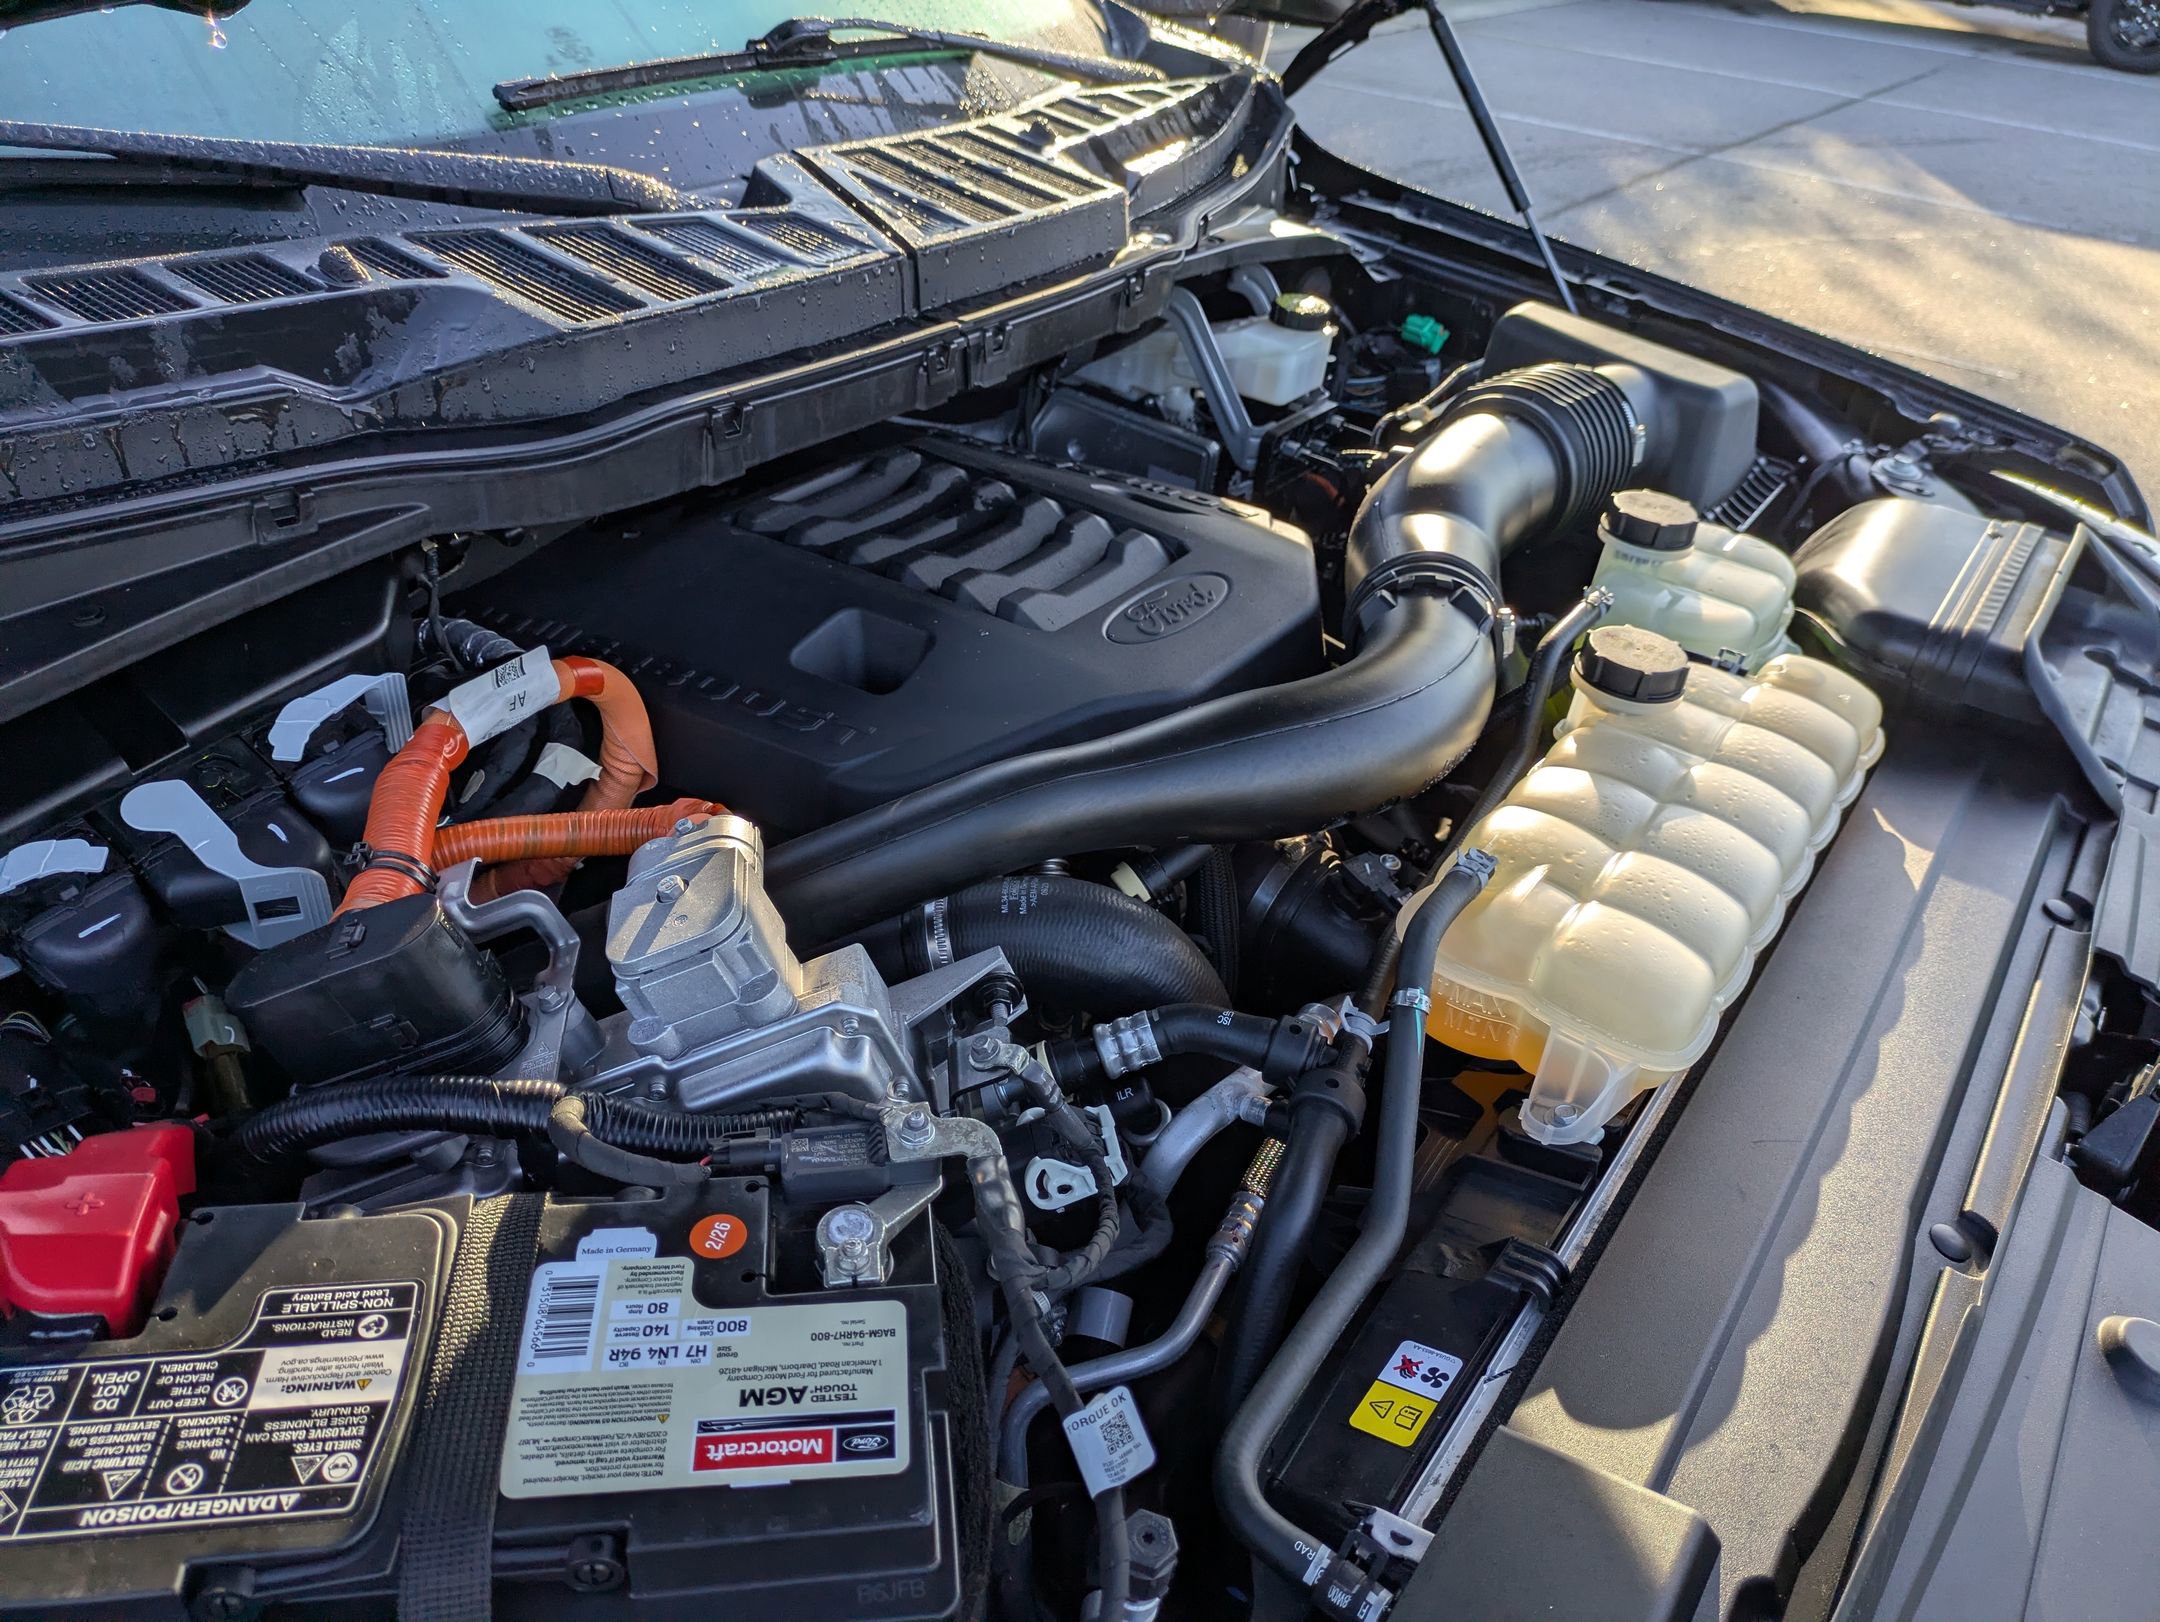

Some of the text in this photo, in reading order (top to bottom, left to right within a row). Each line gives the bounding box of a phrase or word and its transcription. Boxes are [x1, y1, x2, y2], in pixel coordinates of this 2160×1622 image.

[1125, 583, 1216, 635] Ford
[509, 690, 526, 711] AF
[1448, 984, 1506, 1018] MAX
[1216, 1014, 1232, 1026] ISC
[1116, 1088, 1134, 1101] ILR
[705, 1222, 731, 1250] 2/26
[615, 1246, 651, 1254] Germany
[292, 1289, 390, 1302] Lead Acid Battery
[281, 1297, 394, 1313] NON-SPILLABLE
[648, 1303, 669, 1314] 80
[272, 1319, 355, 1331] INSTRUCTIONS.
[642, 1324, 669, 1336] 140
[717, 1320, 748, 1332] 800
[322, 1328, 352, 1337] READ
[810, 1328, 896, 1342] BAGM-94RH7-800
[608, 1345, 707, 1361] H7 LN4 94R
[717, 1345, 732, 1353] Size
[160, 1361, 219, 1373] CHILDREN.
[335, 1363, 359, 1371] hands
[743, 1364, 778, 1374] Michigan
[779, 1362, 817, 1372] Dearborn,
[818, 1361, 840, 1369] Road,
[841, 1359, 877, 1368] American
[277, 1366, 313, 1374] handling.
[362, 1368, 393, 1376] Cancer
[820, 1368, 873, 1378] Manufactured
[91, 1371, 141, 1384] OPEN.
[156, 1372, 215, 1385] REACH OF
[290, 1371, 343, 1383] Reproductive
[727, 1373, 763, 1382] Company
[764, 1373, 787, 1381] Motor
[92, 1384, 130, 1398] NOT
[171, 1385, 210, 1396] OF THE
[280, 1380, 356, 1393] WARNING:
[739, 1386, 808, 1407] AGM
[811, 1393, 857, 1402] TESTED
[93, 1398, 119, 1411] DO
[147, 1397, 207, 1409] KEEP OUT
[310, 1405, 370, 1417] OR INJURY.
[1067, 1392, 1126, 1433] TORQUE OK
[177, 1414, 231, 1427] SMOKING
[264, 1415, 367, 1430] CAUSE BLINDNESS
[68, 1420, 160, 1435] SEVERE BURNS.
[180, 1426, 227, 1438] FLAMES
[18, 1429, 52, 1440] HELP
[68, 1431, 156, 1447] BLINDNESS OR
[245, 1426, 365, 1442] EXPLOSIVE GASES CAN
[20, 1440, 47, 1450] GET
[176, 1438, 224, 1449] SPARKS
[292, 1439, 362, 1453] SHIELD EYES.
[629, 1438, 667, 1446] distributor
[848, 1436, 882, 1448] Ford
[83, 1443, 151, 1457] CAN CAUSE
[209, 1449, 226, 1459] NO
[620, 1446, 653, 1455] complete
[706, 1438, 823, 1461] Motorcraft
[8, 1457, 39, 1467] WITH
[62, 1455, 148, 1472] SULFURIC ACID
[631, 1454, 665, 1462] Warranty
[622, 1462, 653, 1470] warranty
[523, 1476, 552, 1484] required
[607, 1471, 622, 1479] your
[79, 1495, 277, 1526] DANGER/POISON
[1294, 1540, 1316, 1560] RAD
